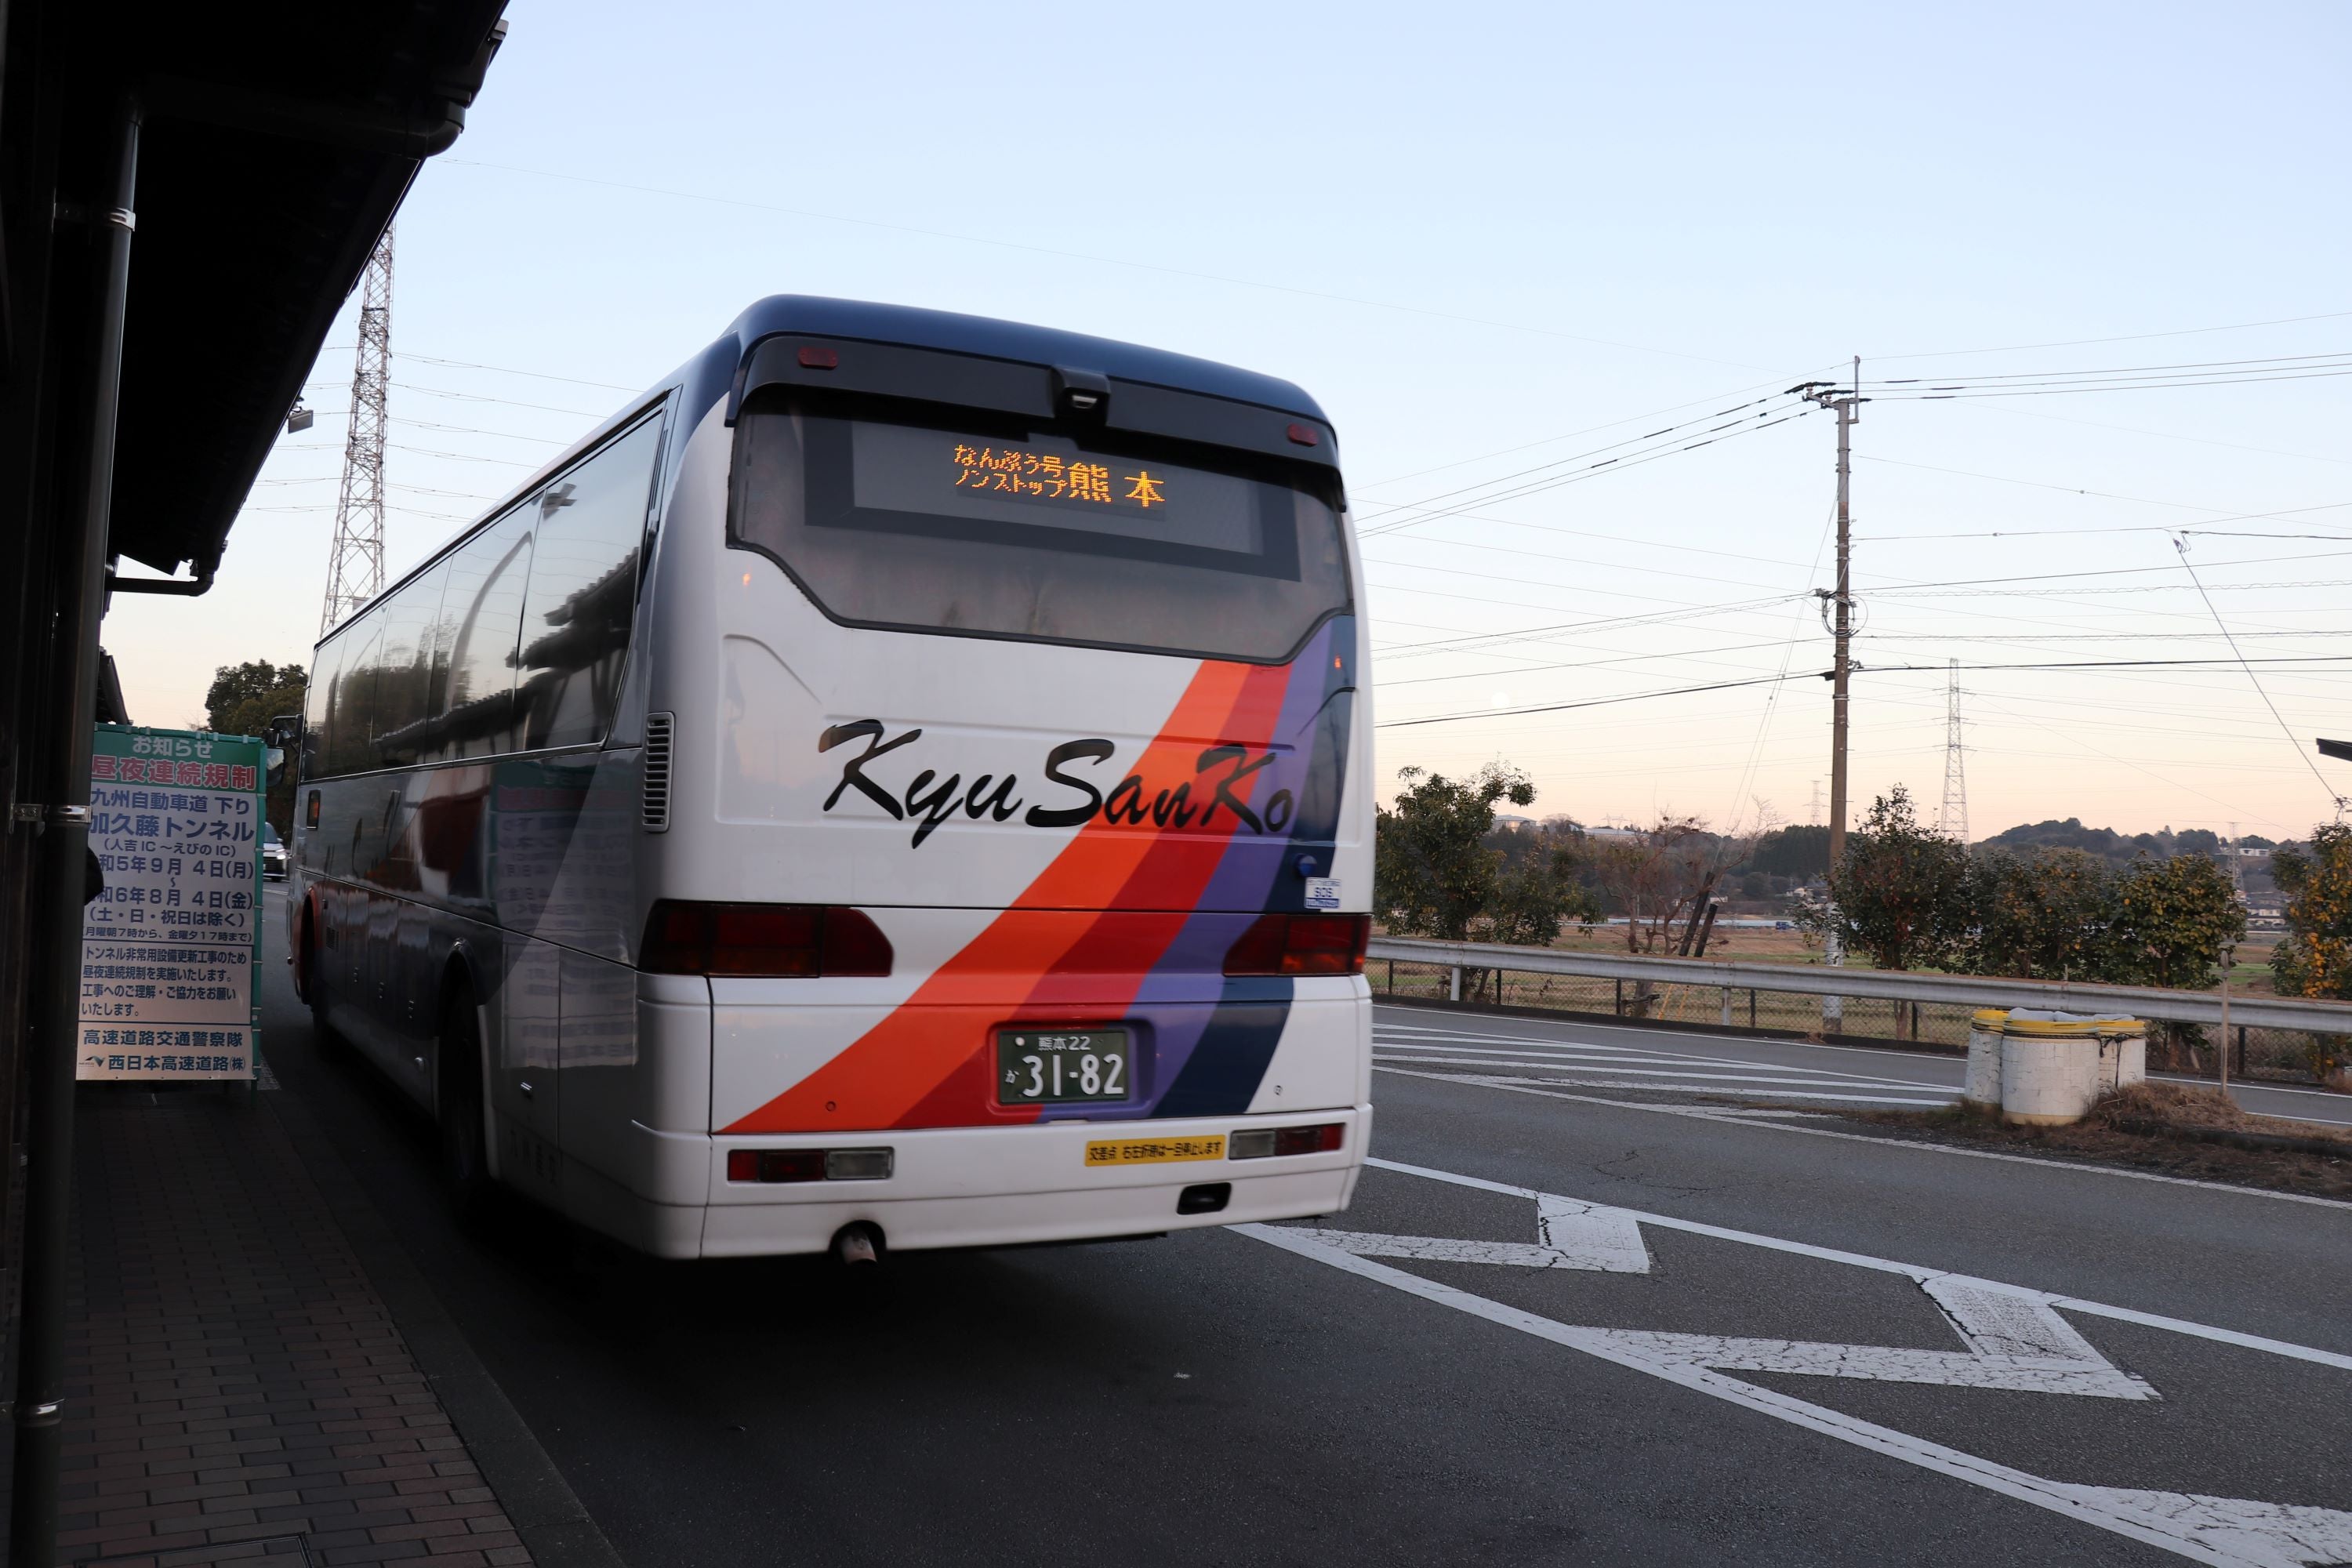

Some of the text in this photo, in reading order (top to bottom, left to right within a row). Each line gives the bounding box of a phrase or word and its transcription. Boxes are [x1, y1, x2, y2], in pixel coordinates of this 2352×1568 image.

[955, 469, 1069, 497] ノンストップ
[132, 735, 213, 759] お知らせ
[92, 754, 257, 790] 昼夜連続規制
[91, 789, 249, 815] 九州自動車道 下り
[89, 813, 255, 842] 加久藤トンネル
[99, 854, 181, 876] 和5年9月
[96, 887, 181, 907] 和6年8月
[82, 927, 252, 942] 月曜朝7時から、金曜夕17時まで)
[86, 946, 247, 964] トンネル非常用設備更新工事のため
[82, 965, 231, 982] 昼夜連続規制を実施いたします。
[82, 983, 237, 1000] 工事へのご理解・ご協力をお願い
[82, 1003, 140, 1017] いたします。
[83, 1029, 243, 1047] 高速道路交通警察隊
[1004, 1054, 1124, 1097] か 31-82
